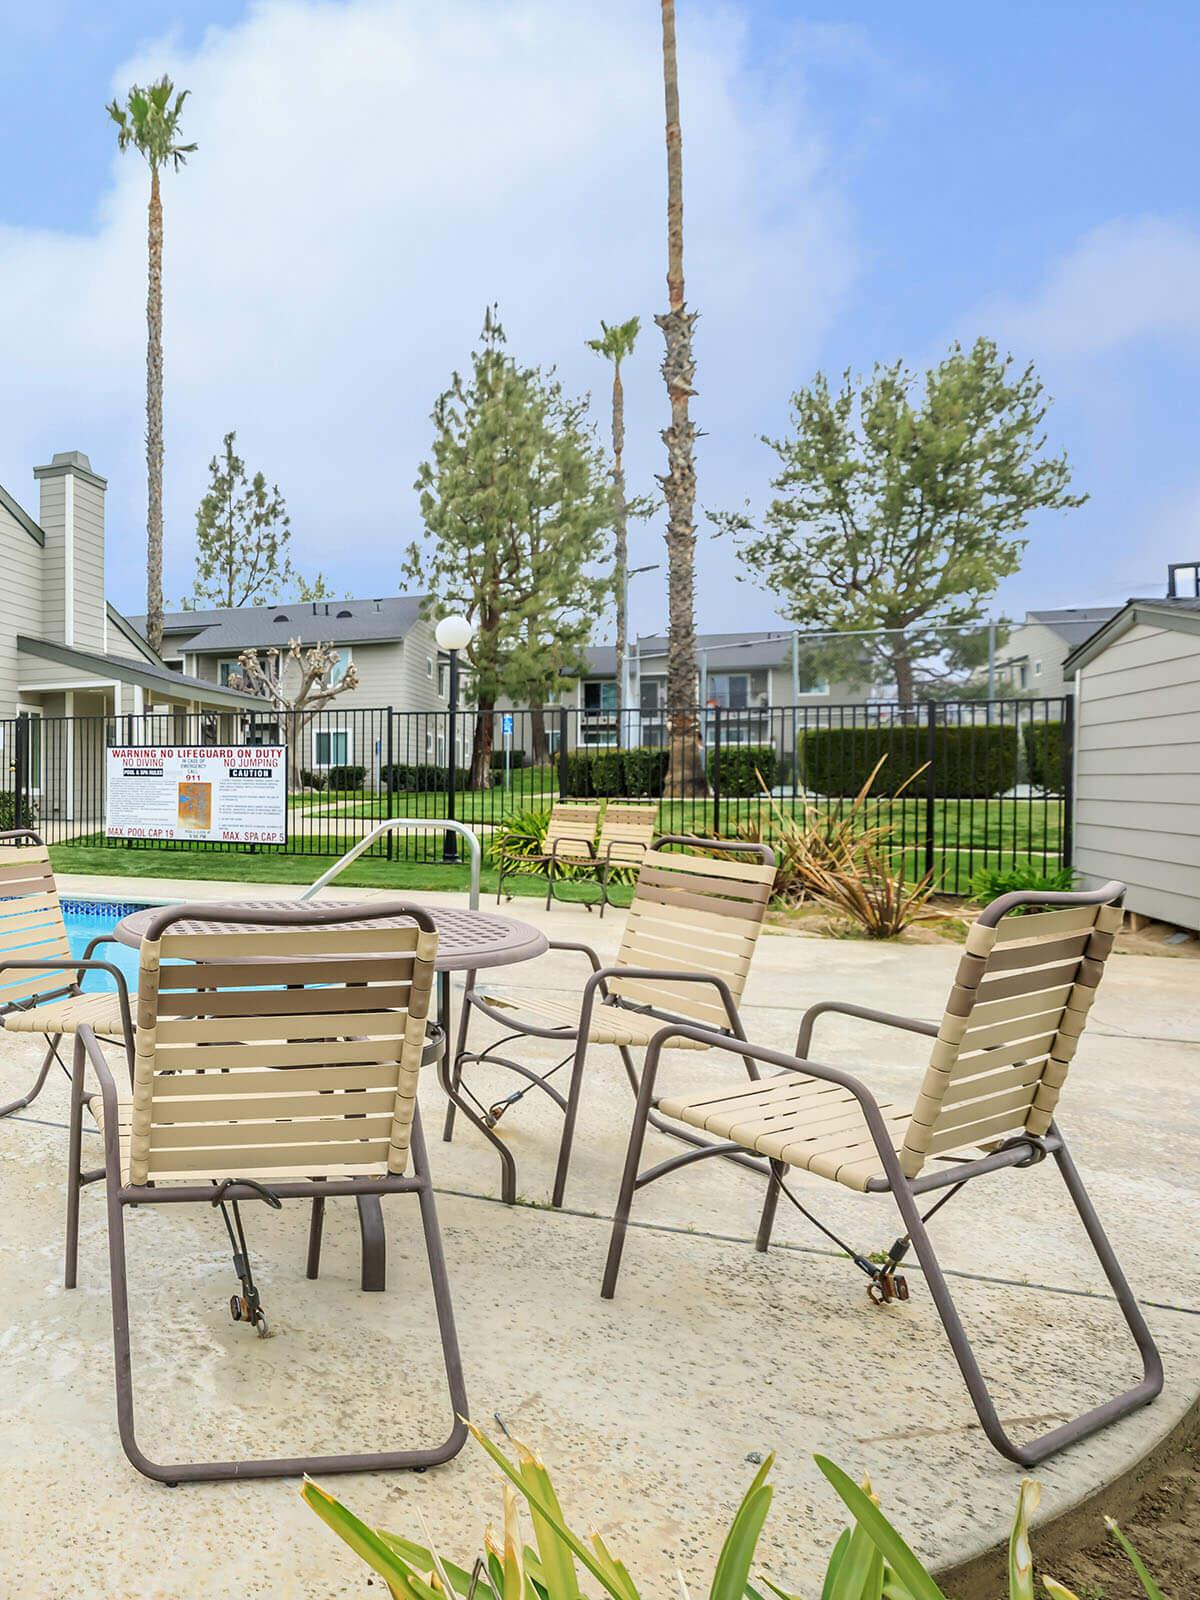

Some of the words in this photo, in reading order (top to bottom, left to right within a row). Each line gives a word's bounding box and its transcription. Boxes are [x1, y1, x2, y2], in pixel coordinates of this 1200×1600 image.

[178, 750, 233, 758] LIFEGUARD
[137, 759, 164, 767] DIVING
[238, 759, 278, 768] JUMPING
[128, 828, 146, 837] POOL
[244, 832, 259, 841] SPA
